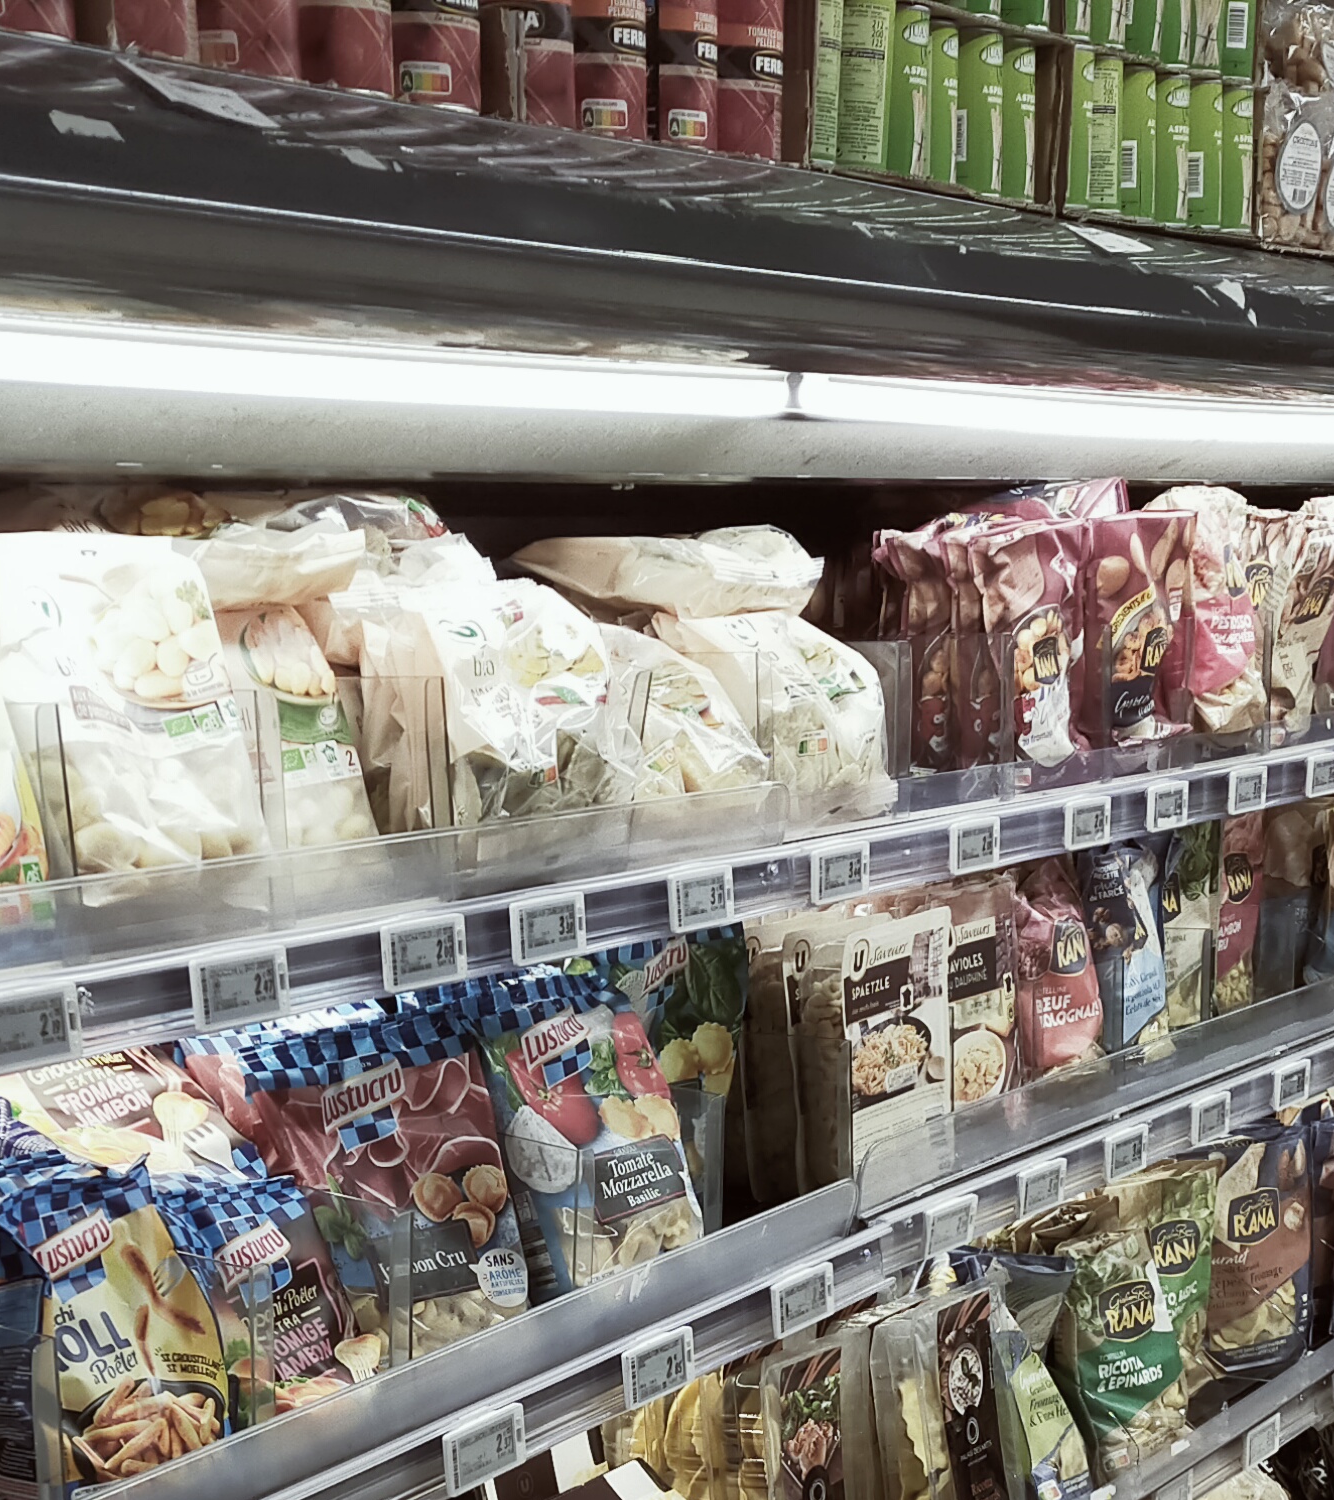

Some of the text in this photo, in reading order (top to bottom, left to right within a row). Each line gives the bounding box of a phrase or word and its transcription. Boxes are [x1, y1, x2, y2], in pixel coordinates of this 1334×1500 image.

[851, 975, 891, 1001] SPAETZLE
[54, 1070, 144, 1117] FROMAGE
[74, 1088, 152, 1128] JAMBON
[607, 1151, 655, 1179] Tomate
[600, 1163, 674, 1200] Mozzarella
[626, 1187, 662, 1209] Basilic
[1233, 1207, 1277, 1238] RANA
[435, 1250, 468, 1273] Cru
[485, 1252, 516, 1268] SANS
[1104, 1301, 1155, 1334] RANA
